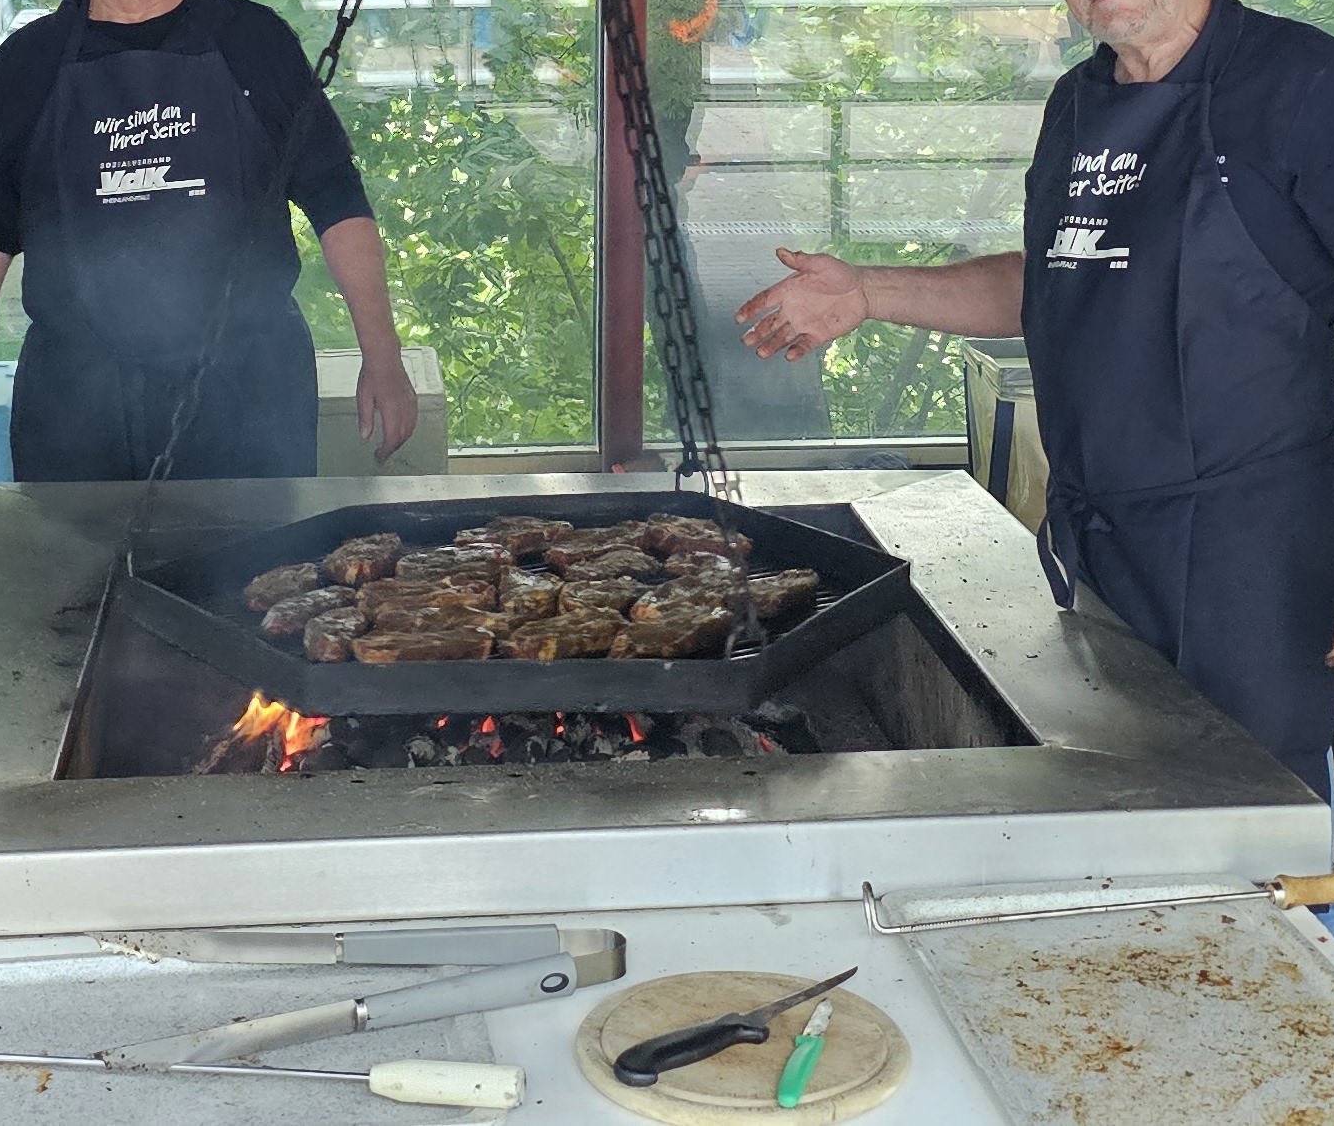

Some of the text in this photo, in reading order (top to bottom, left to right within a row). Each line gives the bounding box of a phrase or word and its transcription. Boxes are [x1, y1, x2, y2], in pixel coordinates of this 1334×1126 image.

[93, 103, 182, 135] Wir sind an
[109, 112, 197, 152] Ihrer Seite!
[1110, 152, 1138, 172] an
[101, 165, 171, 192] VdK
[1068, 163, 1147, 198] er Seite!
